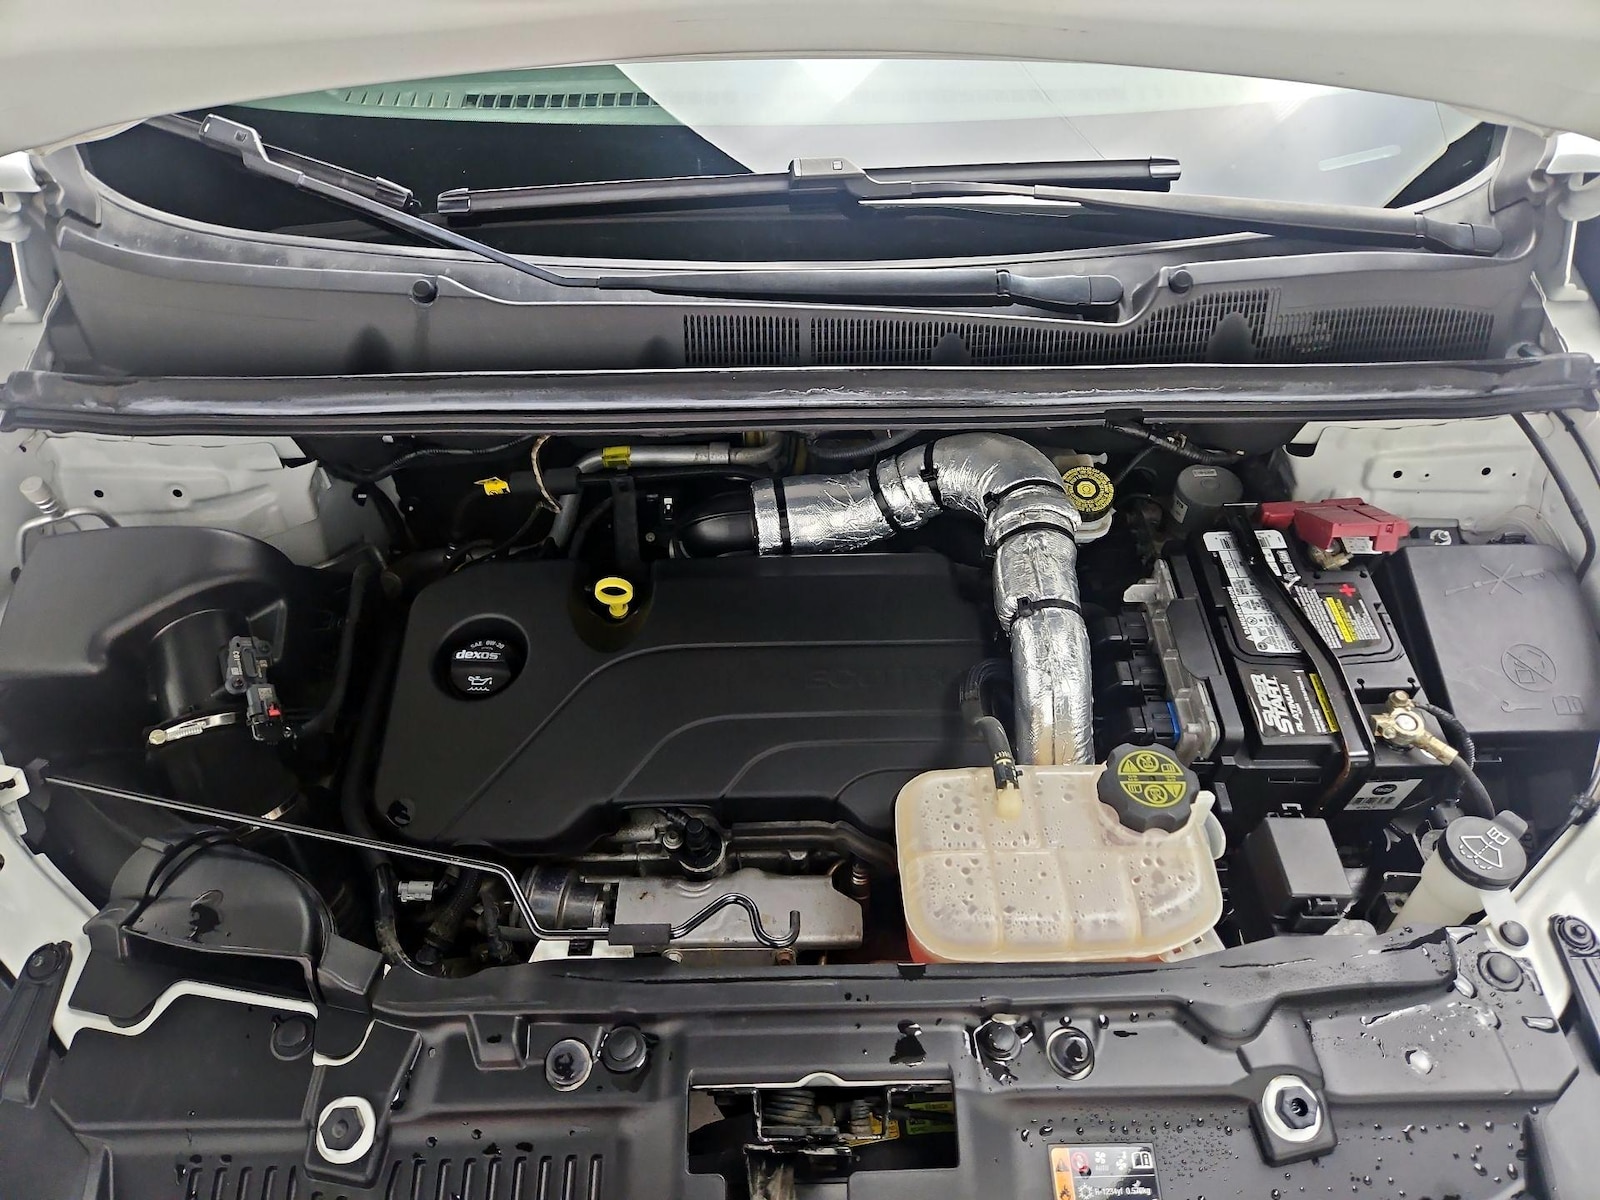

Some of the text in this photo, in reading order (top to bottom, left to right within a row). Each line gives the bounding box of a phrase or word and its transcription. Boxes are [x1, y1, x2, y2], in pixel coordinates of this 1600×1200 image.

[456, 650, 501, 660] dexos
[1250, 674, 1275, 726] SUPER
[1264, 675, 1295, 735] START
[1280, 683, 1305, 733] PLATINUM
